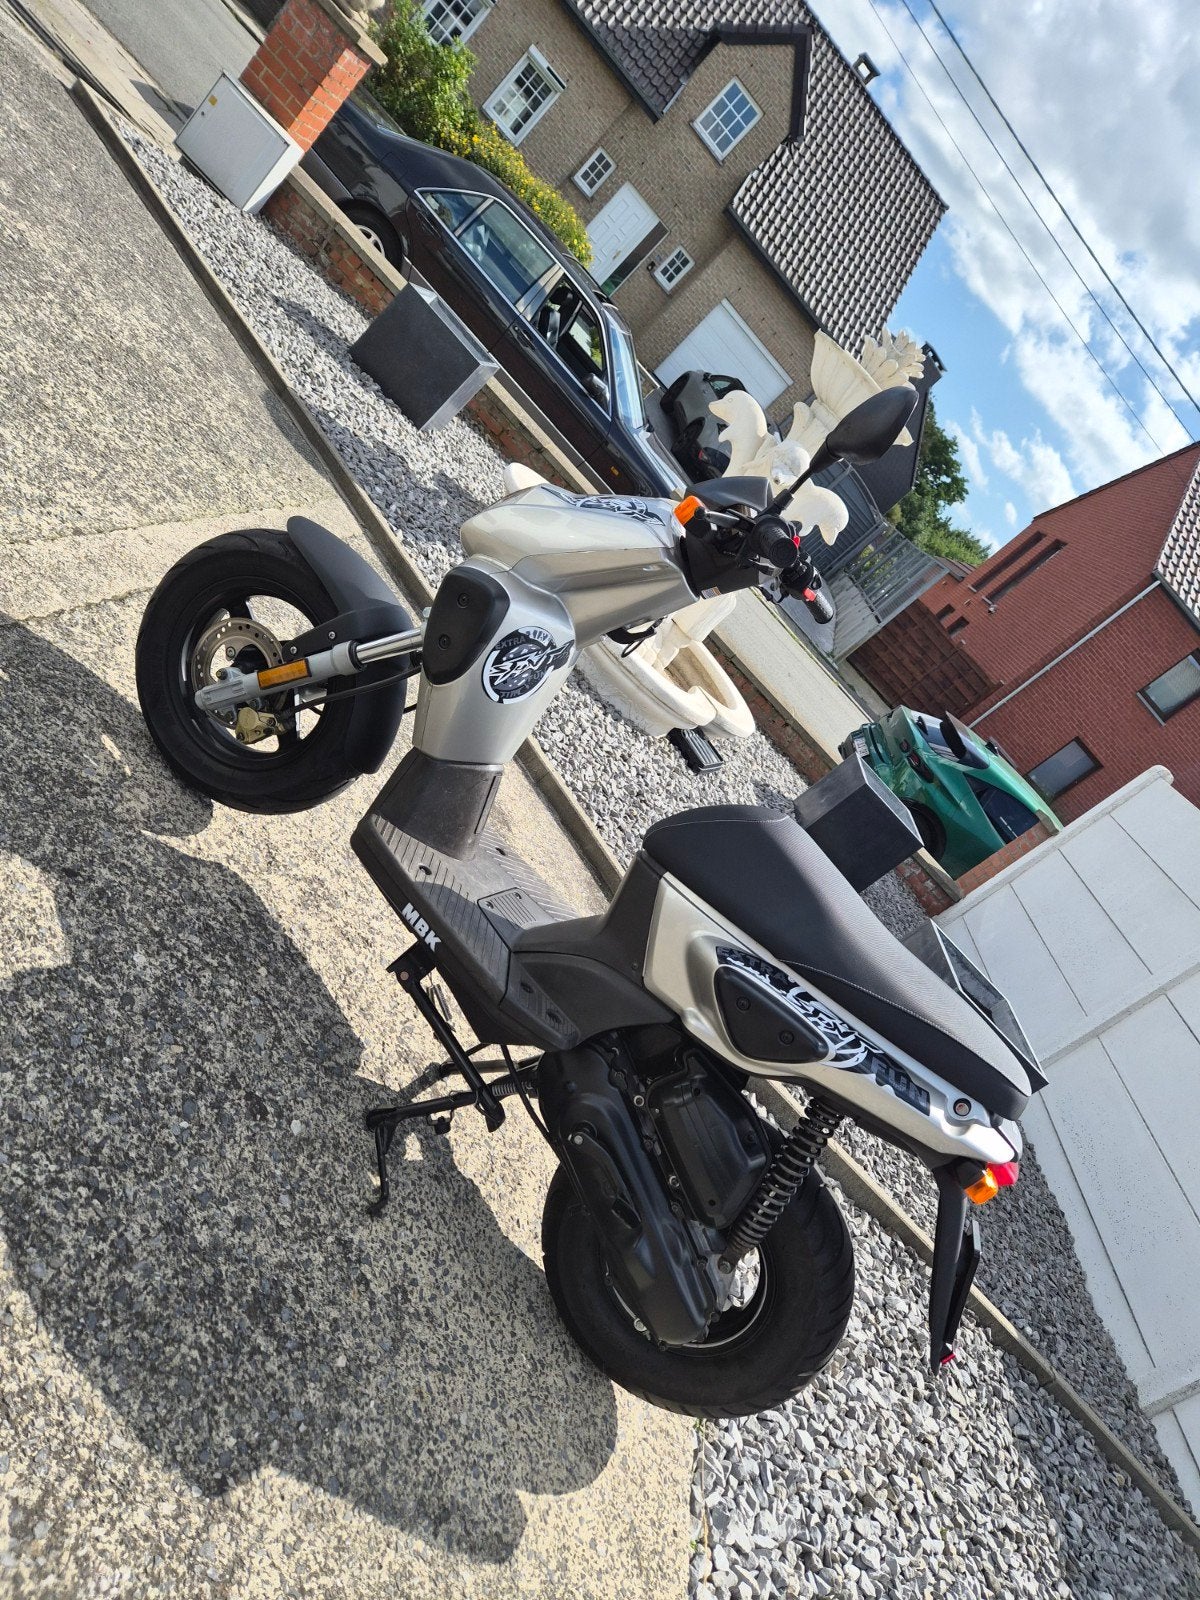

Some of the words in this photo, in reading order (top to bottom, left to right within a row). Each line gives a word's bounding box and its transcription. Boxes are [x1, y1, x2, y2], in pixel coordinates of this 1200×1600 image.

[495, 637, 526, 650] EXTRA
[402, 903, 441, 952] MBK
[872, 1057, 930, 1106] FUN
